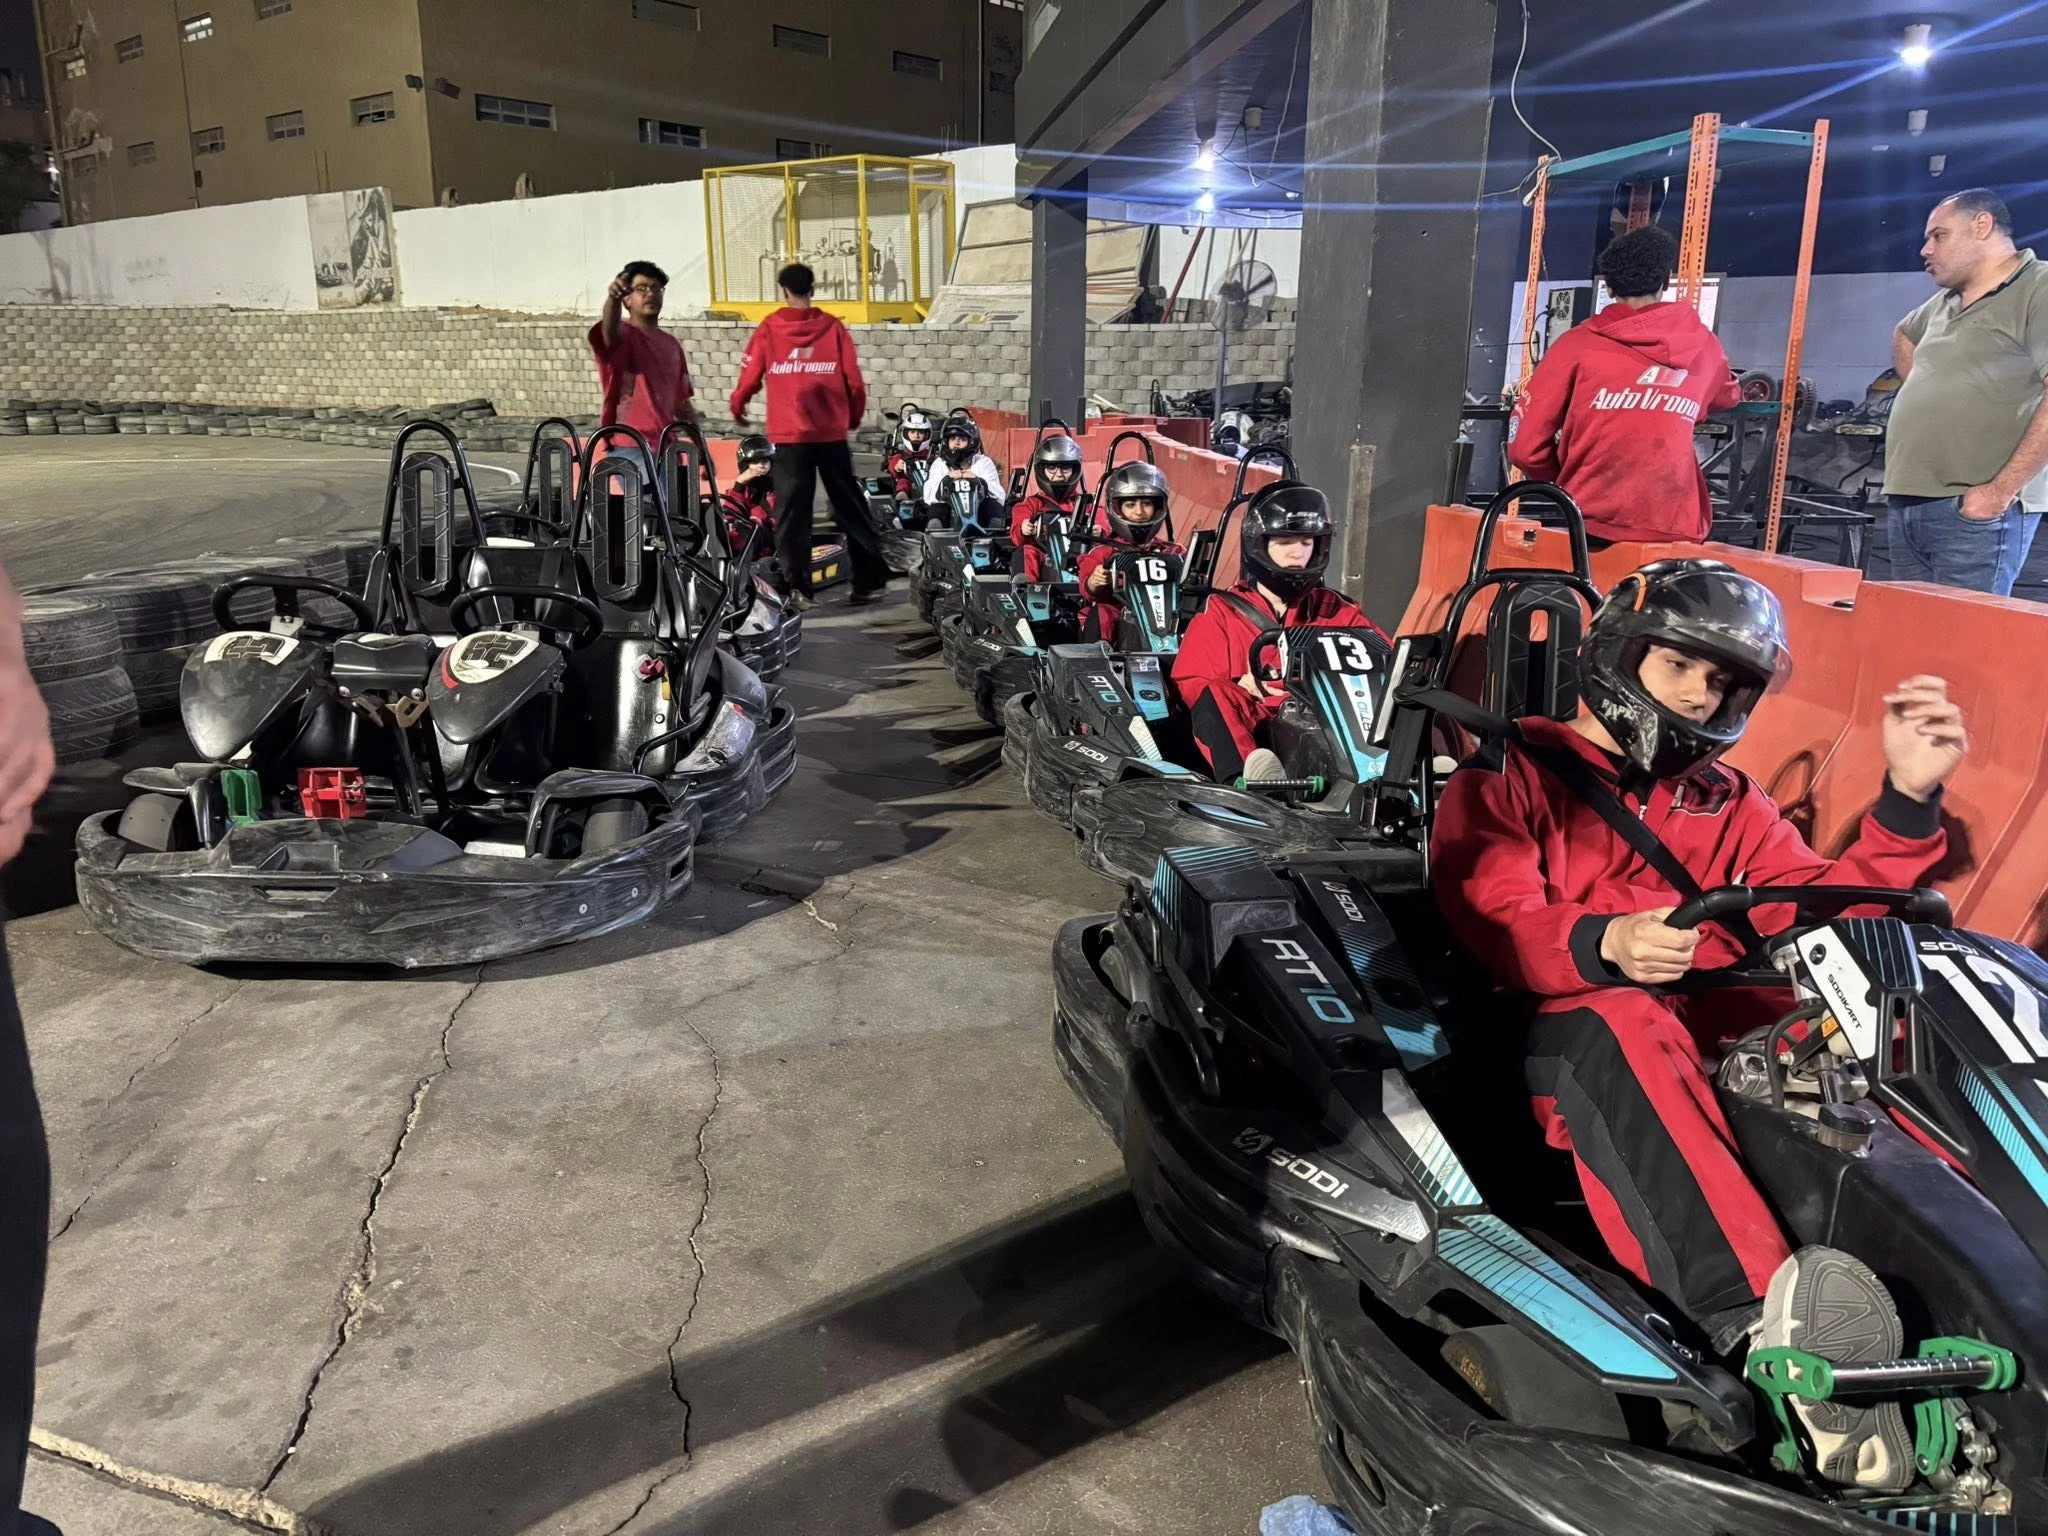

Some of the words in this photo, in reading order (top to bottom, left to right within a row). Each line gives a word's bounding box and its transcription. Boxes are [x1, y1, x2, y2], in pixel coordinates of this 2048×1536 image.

[954, 480, 971, 492] 18
[1135, 559, 1168, 582] 16
[1317, 636, 1374, 671] 13
[1076, 745, 1109, 763] SODI
[1333, 893, 1366, 923] SODI
[1920, 941, 1980, 956] SODI
[1261, 938, 1356, 1024] RT10
[1827, 973, 1863, 1029] SODIKART
[1265, 1146, 1350, 1199] SODI
